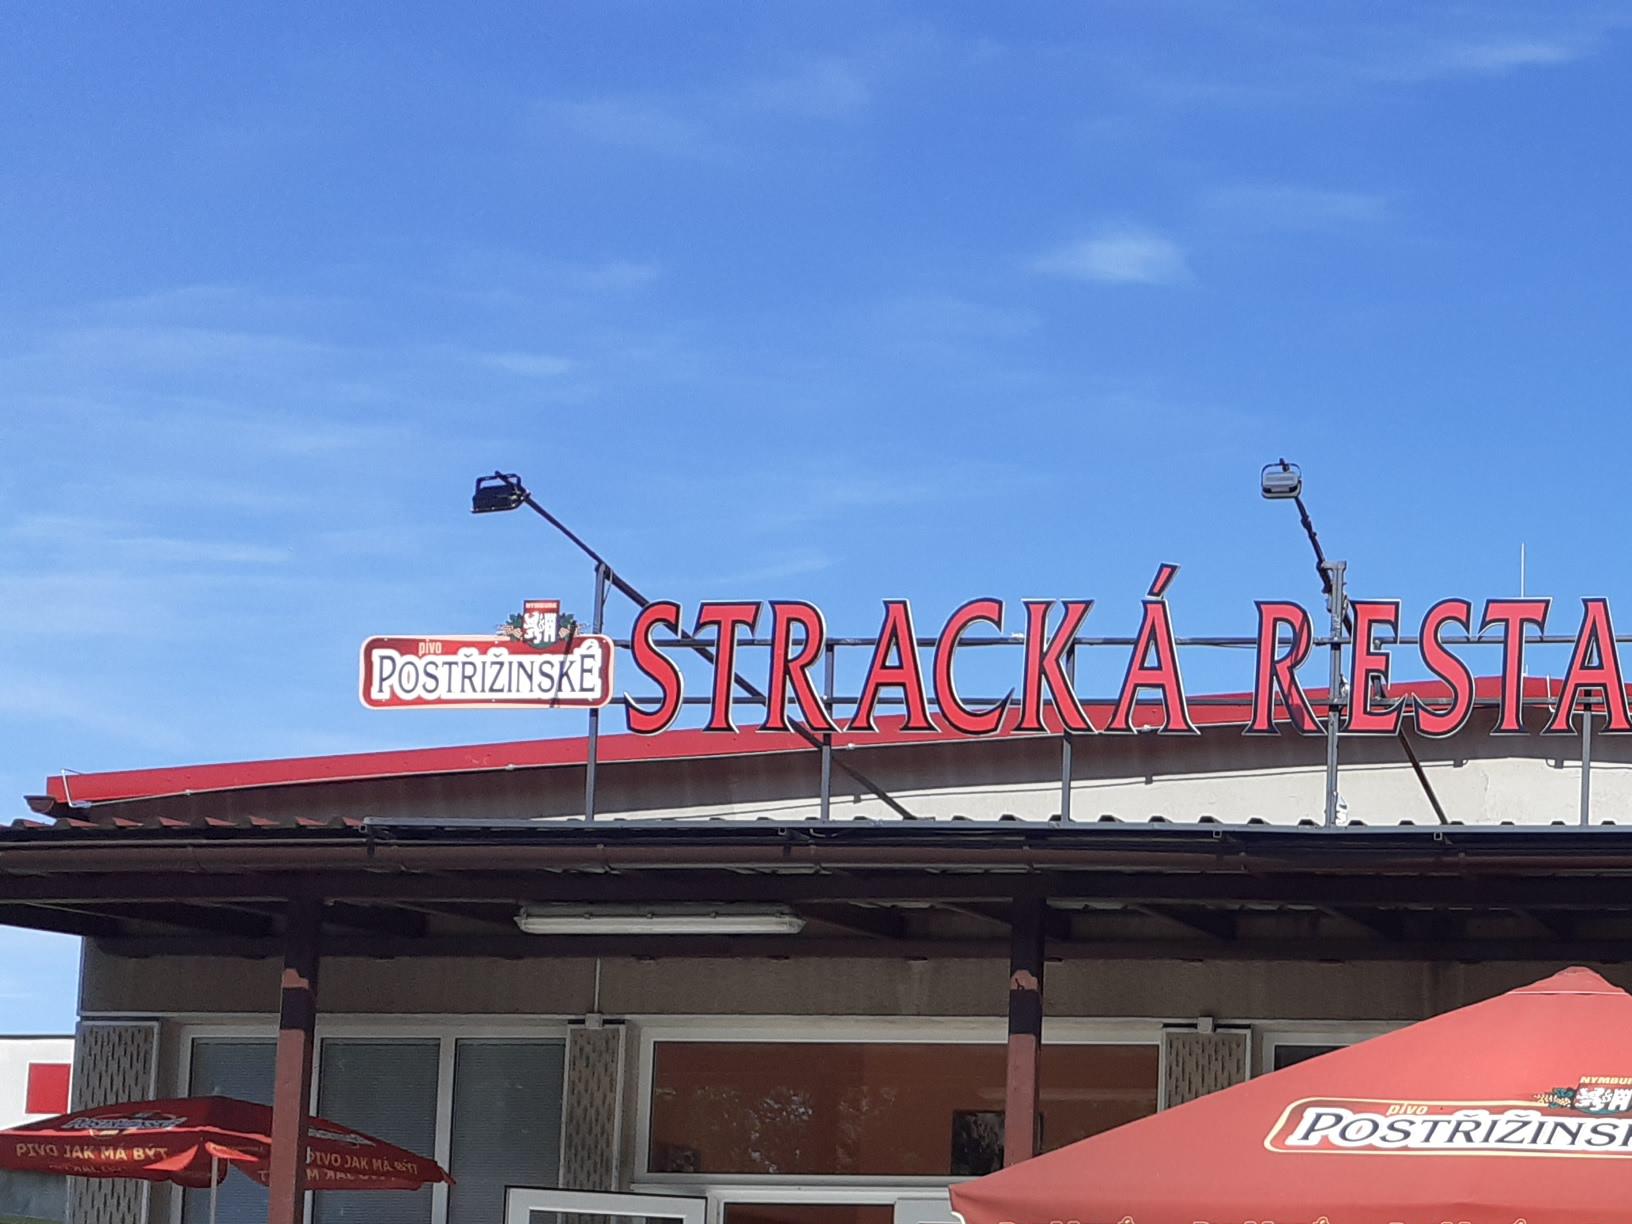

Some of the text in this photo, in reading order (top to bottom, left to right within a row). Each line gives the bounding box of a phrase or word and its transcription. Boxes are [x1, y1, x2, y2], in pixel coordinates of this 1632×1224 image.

[418, 640, 442, 656] pivo
[624, 562, 1200, 735] STRACKÁ
[376, 643, 597, 694] POSTŘIŽINSKÉ
[1386, 1102, 1428, 1116] pivo
[16, 1142, 168, 1161] PIVO JAK MÁ BÝT
[344, 1155, 369, 1170] JAK
